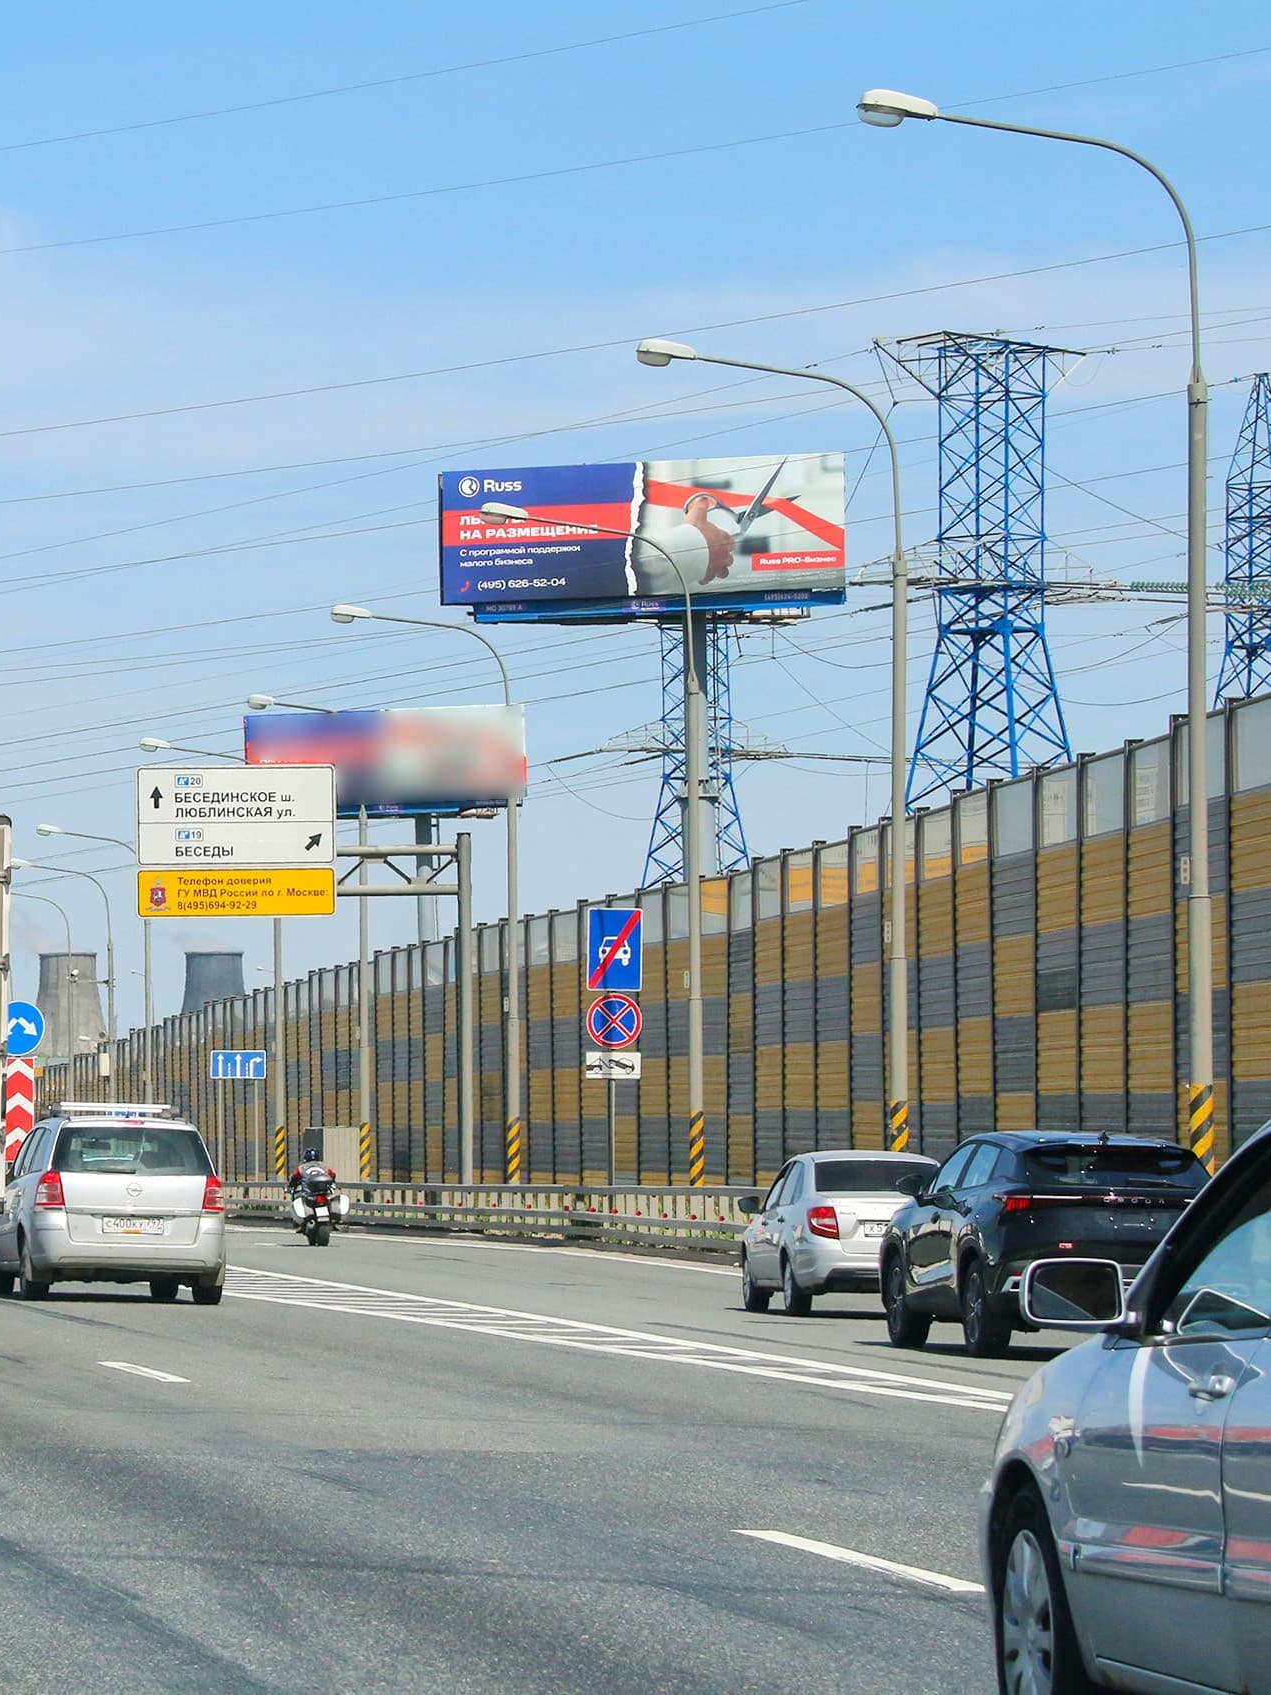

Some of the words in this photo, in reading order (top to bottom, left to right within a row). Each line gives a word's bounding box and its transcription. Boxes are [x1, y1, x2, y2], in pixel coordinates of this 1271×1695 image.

[484, 479, 522, 493] Russ
[459, 529, 483, 541] НА
[485, 524, 599, 539] РАЗМЕЩЕНИЕ
[460, 549, 467, 557] С
[469, 546, 526, 559] программой
[527, 545, 581, 556] поддержки
[460, 559, 493, 568] малого
[495, 557, 533, 566] бизнеса
[782, 555, 837, 564] PRO-Бизнес
[477, 579, 506, 591] (495)
[508, 577, 566, 588] 626-52-04
[190, 777, 201, 785] 20
[175, 792, 276, 804] БЕСЕДИНСКОЕ
[281, 794, 295, 802] ш.
[175, 807, 272, 818] ЛЮБЛИНСКАЯ
[277, 809, 296, 819] ул.
[191, 831, 202, 840] 19
[175, 846, 233, 858] БЕСЕДЫ
[178, 877, 223, 886] Телефон
[226, 877, 271, 886] доверия
[177, 889, 190, 898] ГУ
[193, 889, 217, 899] МВД
[220, 889, 258, 897] России
[287, 888, 329, 897] Москве:
[178, 901, 257, 911] 8(495)694-92-29
